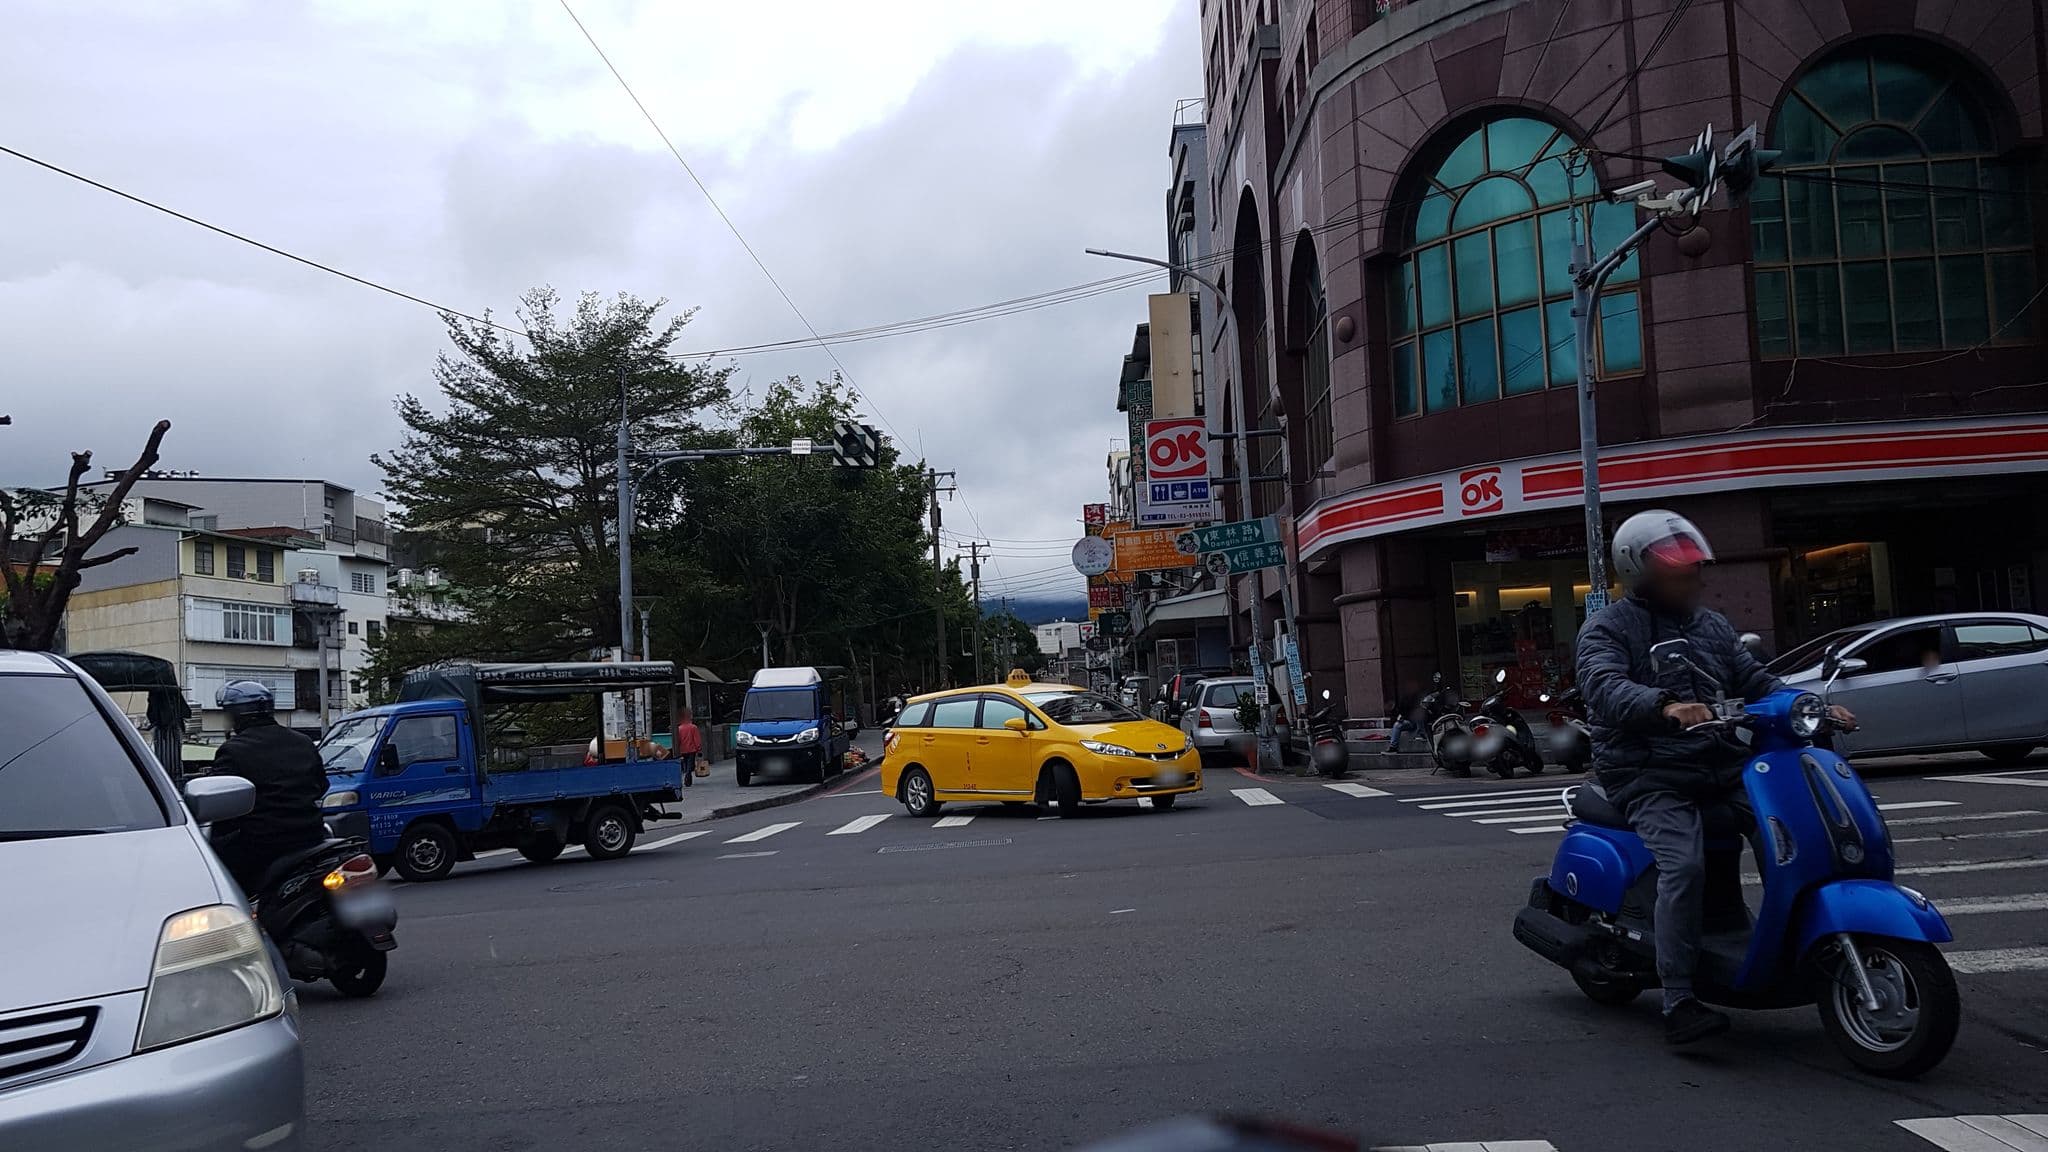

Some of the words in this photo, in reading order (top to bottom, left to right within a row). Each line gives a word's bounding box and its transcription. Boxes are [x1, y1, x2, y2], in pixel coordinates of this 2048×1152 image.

[1150, 430, 1206, 467] OK
[1192, 486, 1207, 494] ATM
[1461, 475, 1503, 507] OK
[1208, 524, 1253, 542] 東林路
[1210, 537, 1241, 548] Donglin
[1238, 544, 1279, 562] 信義路
[1240, 558, 1264, 569] Xinyi
[370, 790, 407, 800] VARICA
